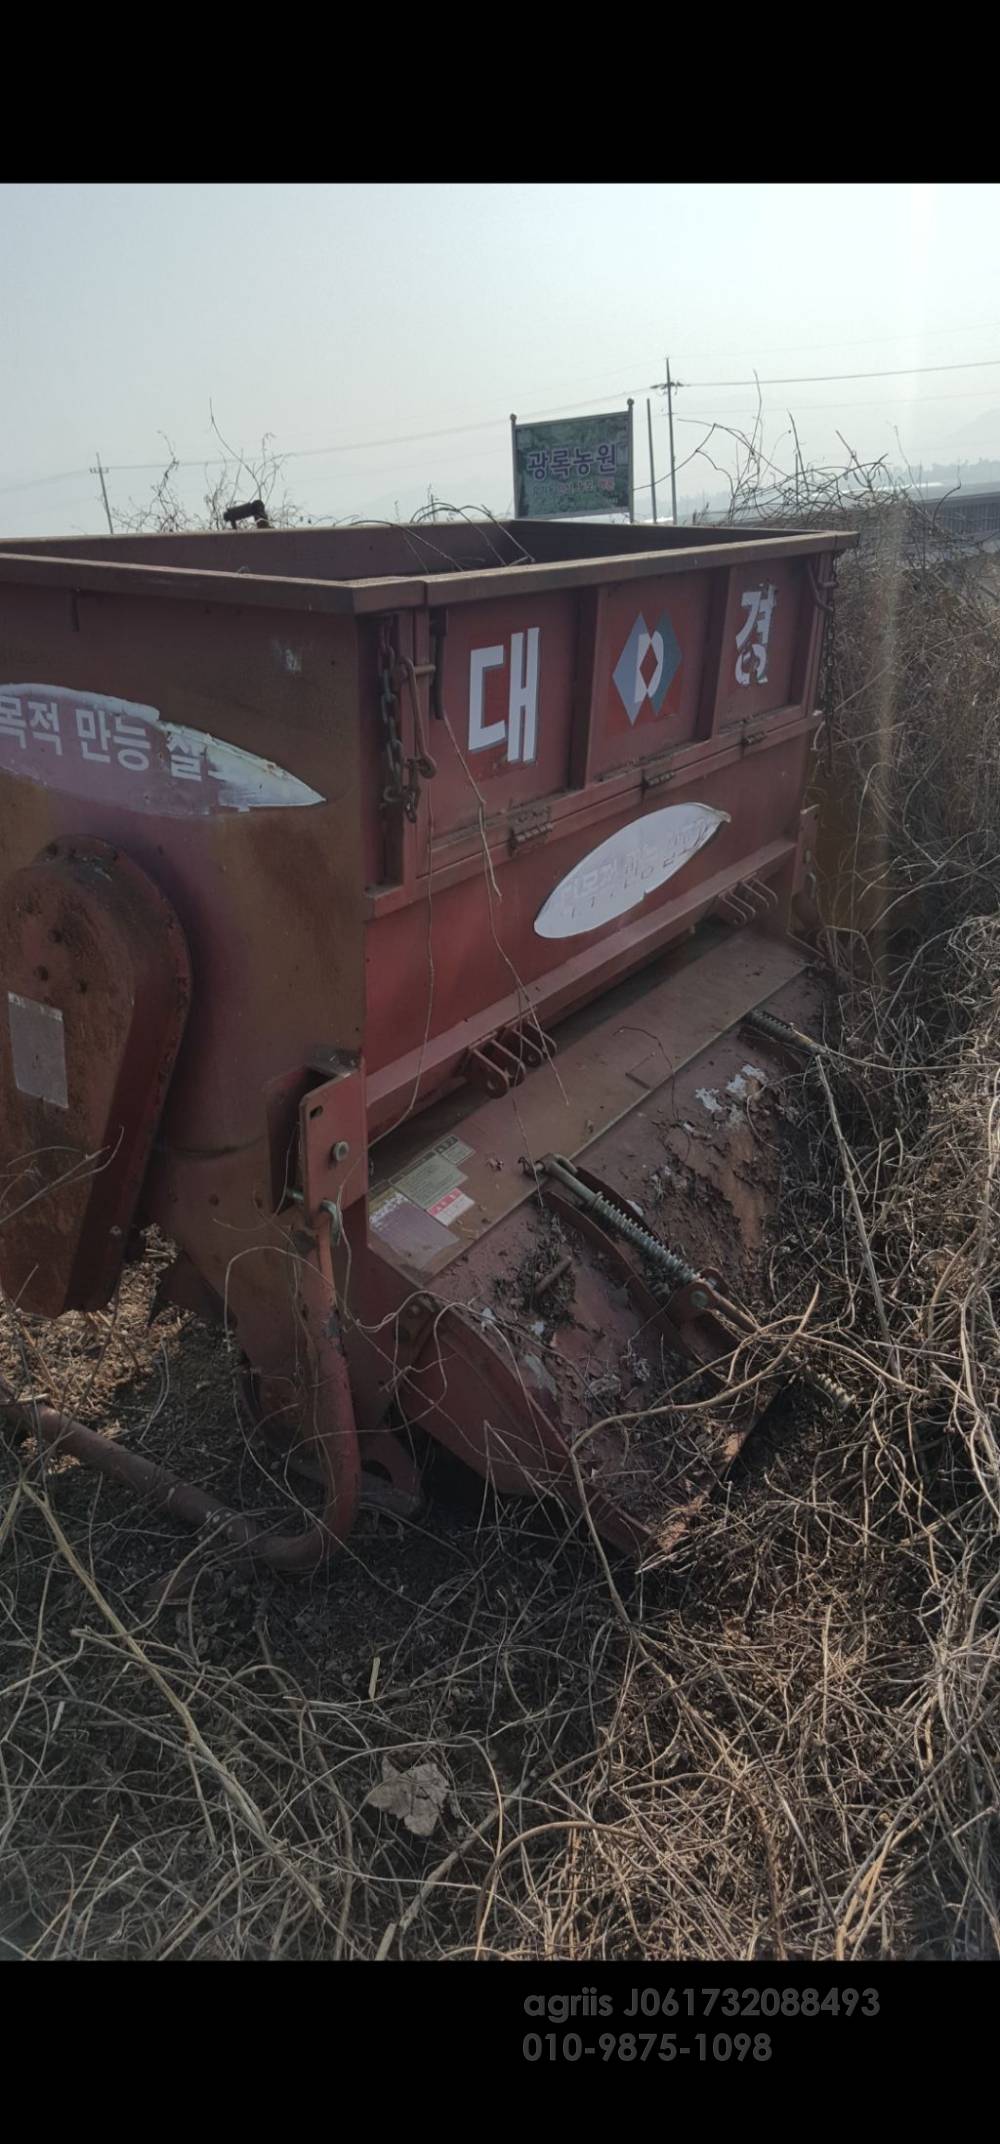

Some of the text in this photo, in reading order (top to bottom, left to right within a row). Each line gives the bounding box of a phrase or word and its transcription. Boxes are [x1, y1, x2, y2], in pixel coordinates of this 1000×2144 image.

[528, 443, 616, 480] 광록농원
[468, 627, 540, 764] 대
[735, 583, 777, 686] 경
[75, 708, 151, 772] 만능
